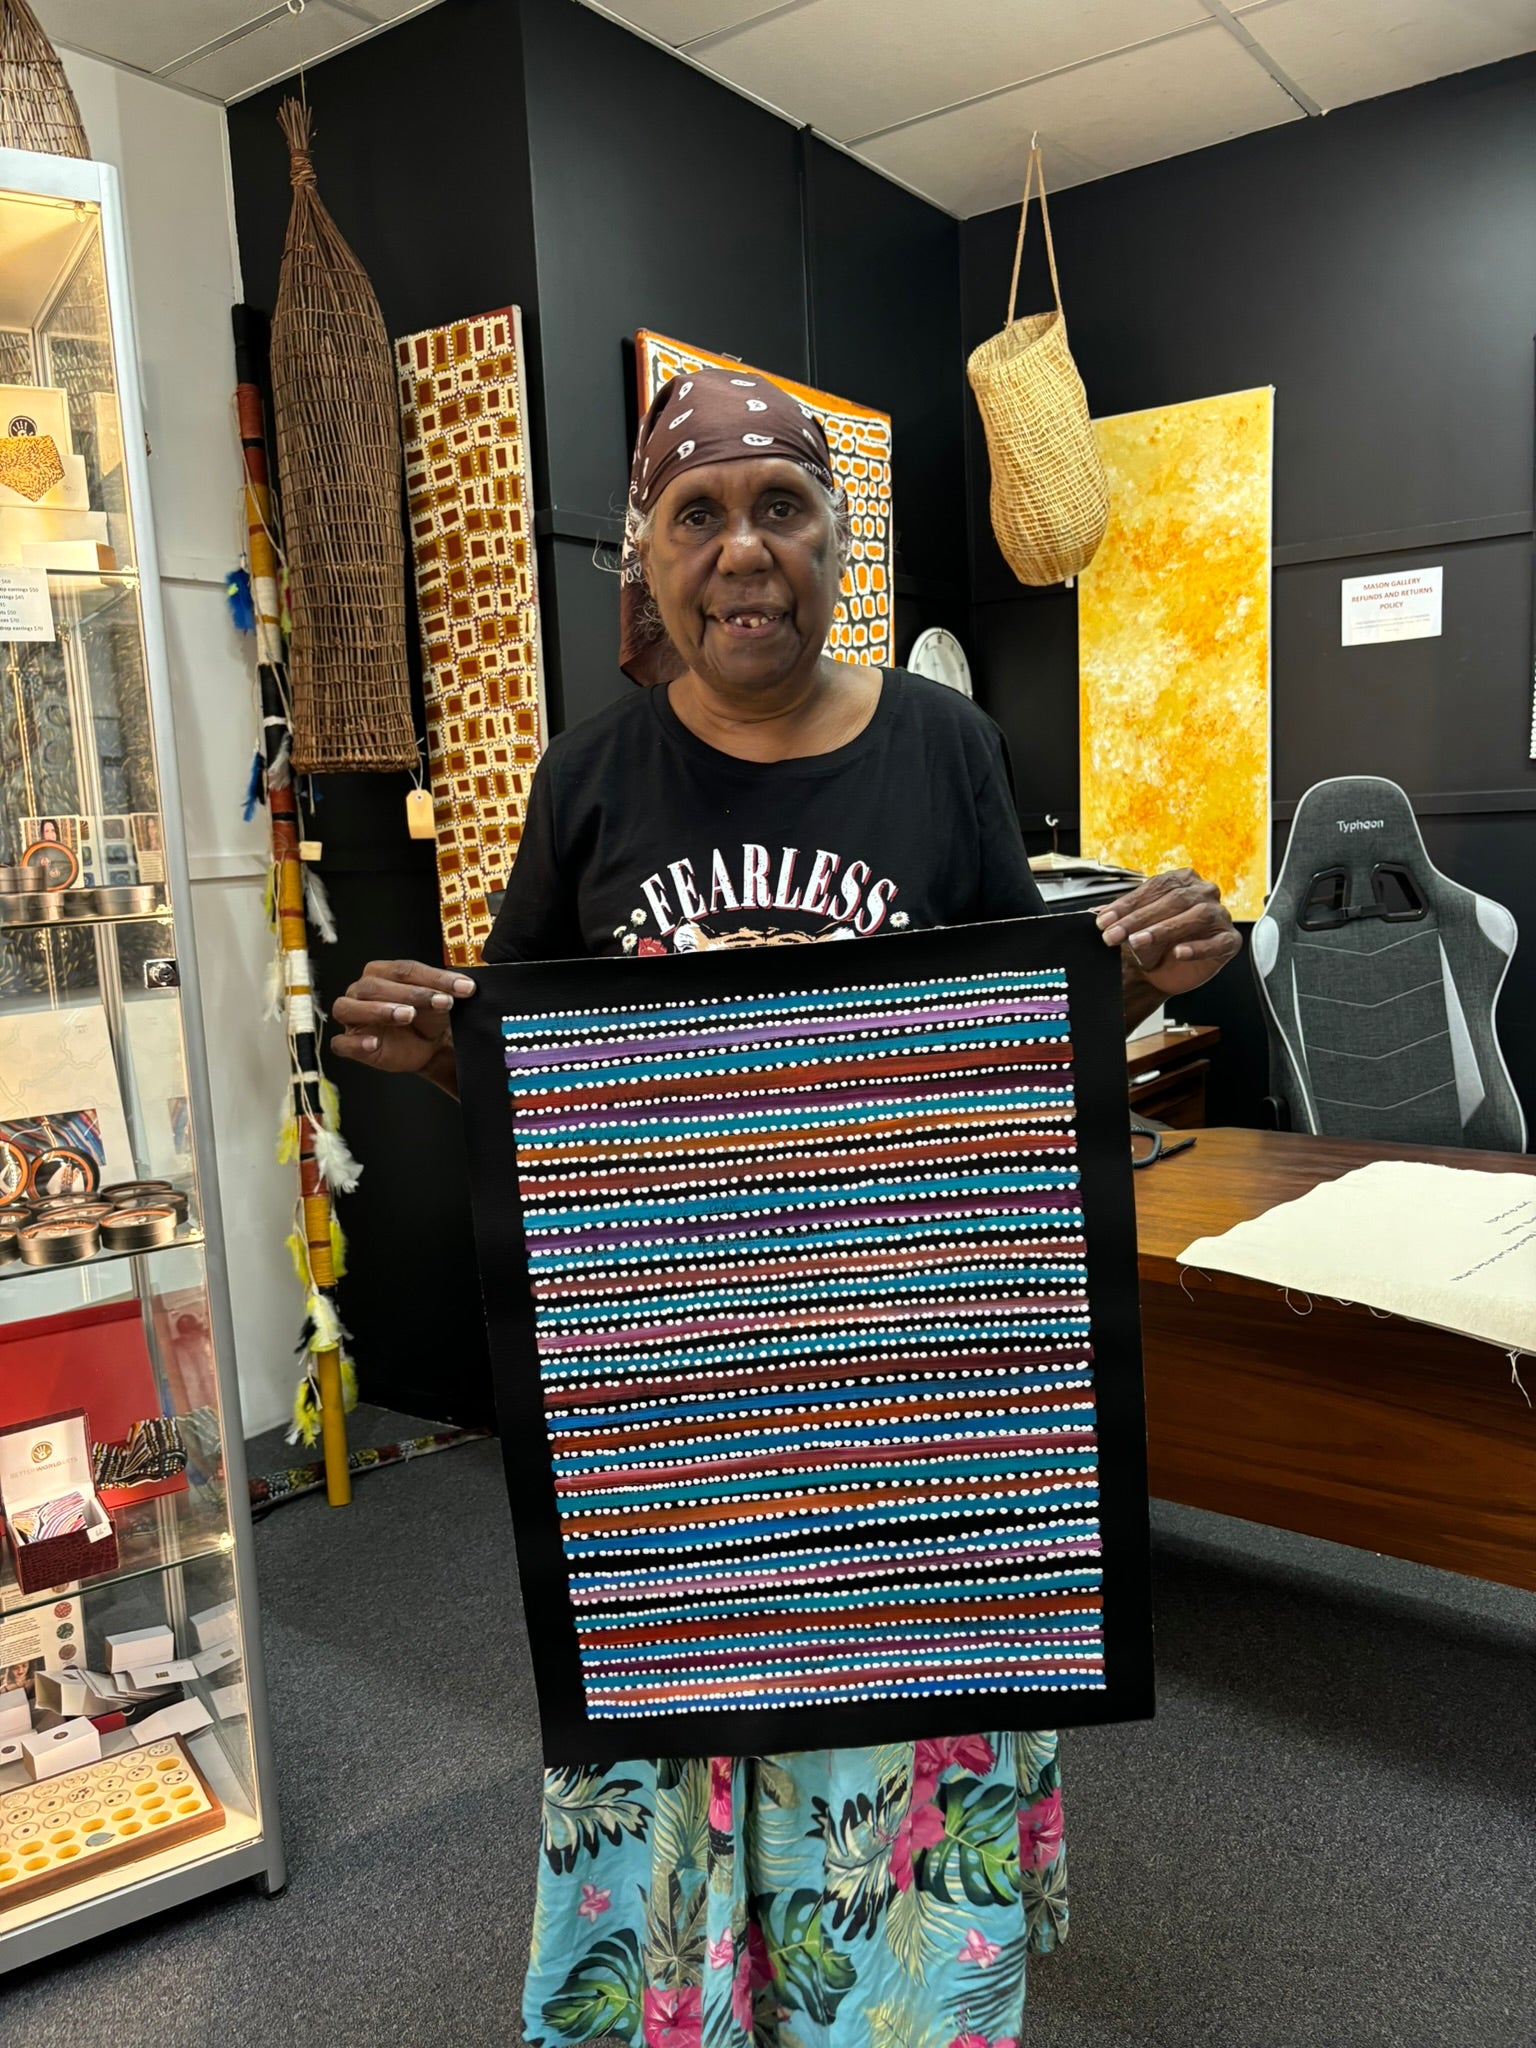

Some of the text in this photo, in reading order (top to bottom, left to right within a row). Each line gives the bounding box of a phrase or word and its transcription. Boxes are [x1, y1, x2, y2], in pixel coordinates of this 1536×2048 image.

[1363, 577, 1421, 591] MASON GALLERY
[1351, 587, 1433, 603] REFUNDS AND RETURNS
[1379, 602, 1403, 610] POLICY
[1336, 820, 1384, 833] Typhoon
[640, 843, 899, 936] FEARLESS
[36, 1461, 61, 1471] WORLD
